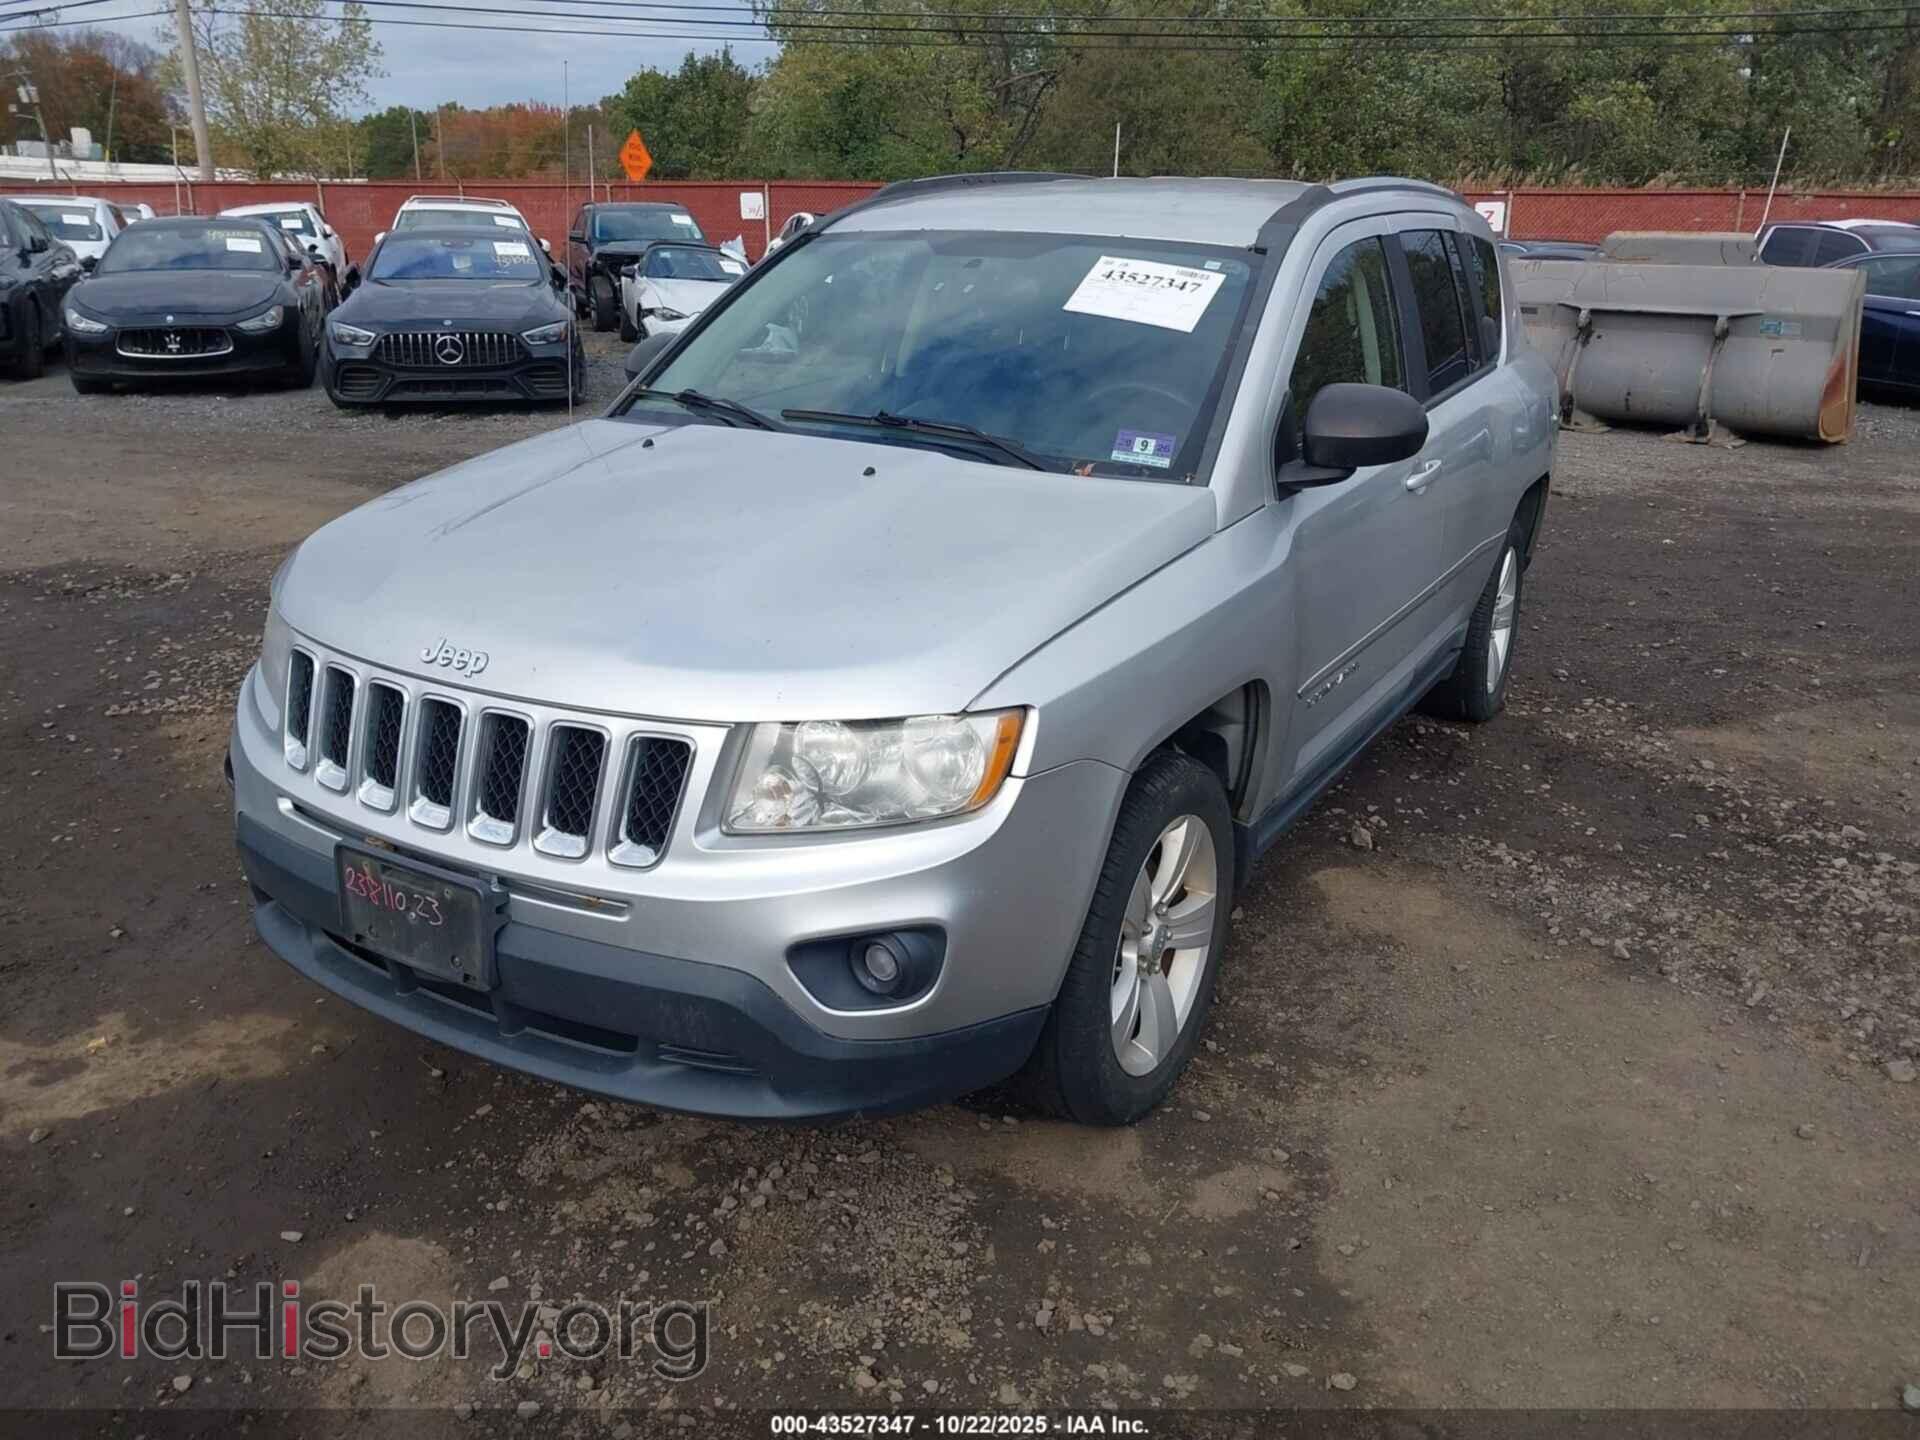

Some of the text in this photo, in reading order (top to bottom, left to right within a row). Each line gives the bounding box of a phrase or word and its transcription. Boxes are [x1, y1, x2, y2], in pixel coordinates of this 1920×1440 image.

[1101, 268, 1203, 294] 43527347
[1139, 439, 1149, 452] 9
[419, 637, 490, 679] Jeep
